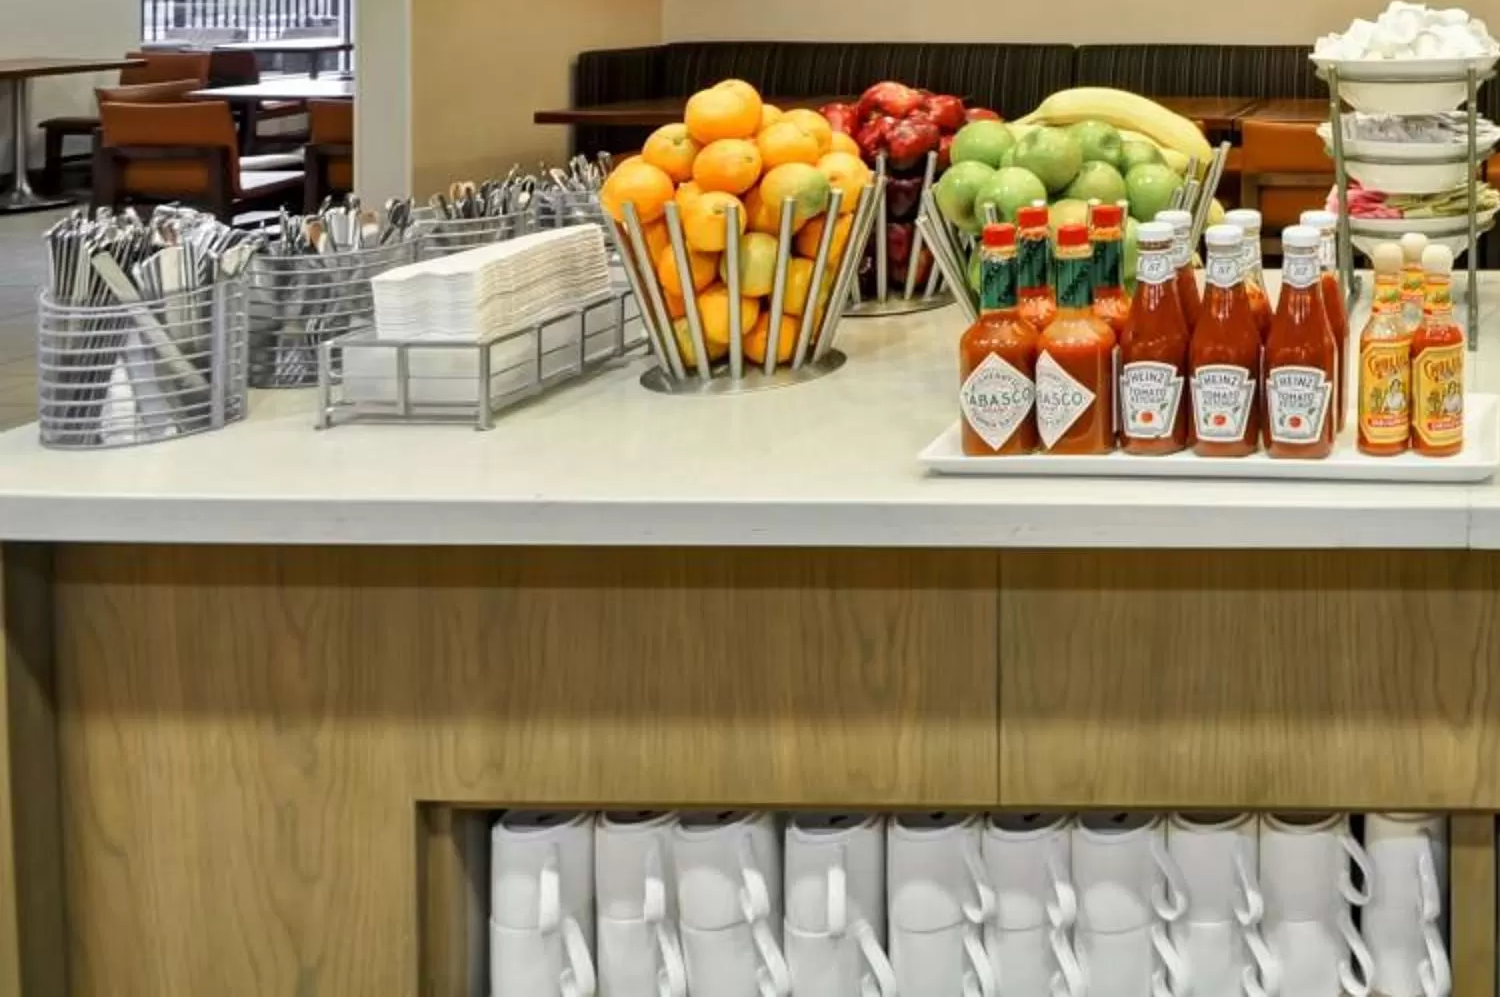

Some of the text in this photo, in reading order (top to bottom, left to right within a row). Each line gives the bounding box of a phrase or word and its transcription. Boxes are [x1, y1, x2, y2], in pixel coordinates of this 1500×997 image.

[1129, 370, 1165, 384] HEINZ
[1203, 374, 1239, 387] HEINZ
[1128, 386, 1167, 397] TOMATO
